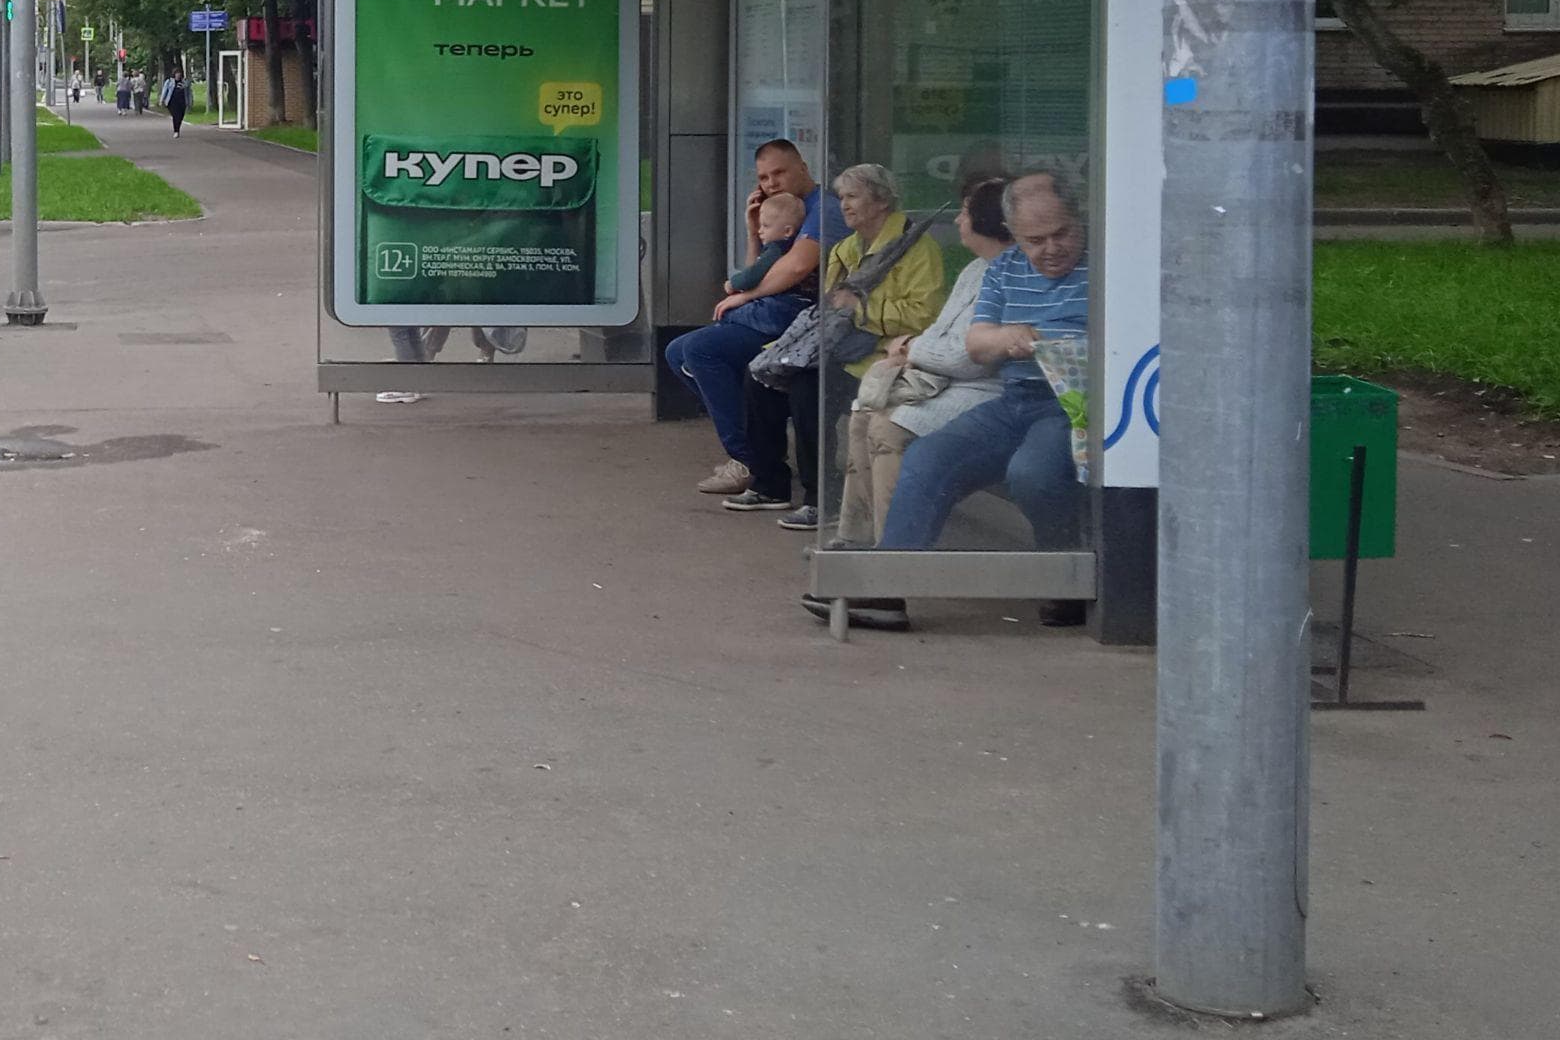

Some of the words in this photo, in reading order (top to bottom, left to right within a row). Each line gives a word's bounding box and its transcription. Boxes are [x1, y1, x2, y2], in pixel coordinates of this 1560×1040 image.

[433, 43, 534, 60] теперь
[557, 91, 583, 101] это
[544, 103, 595, 117] супер!
[384, 151, 578, 187] купер
[380, 249, 413, 272] 12+
